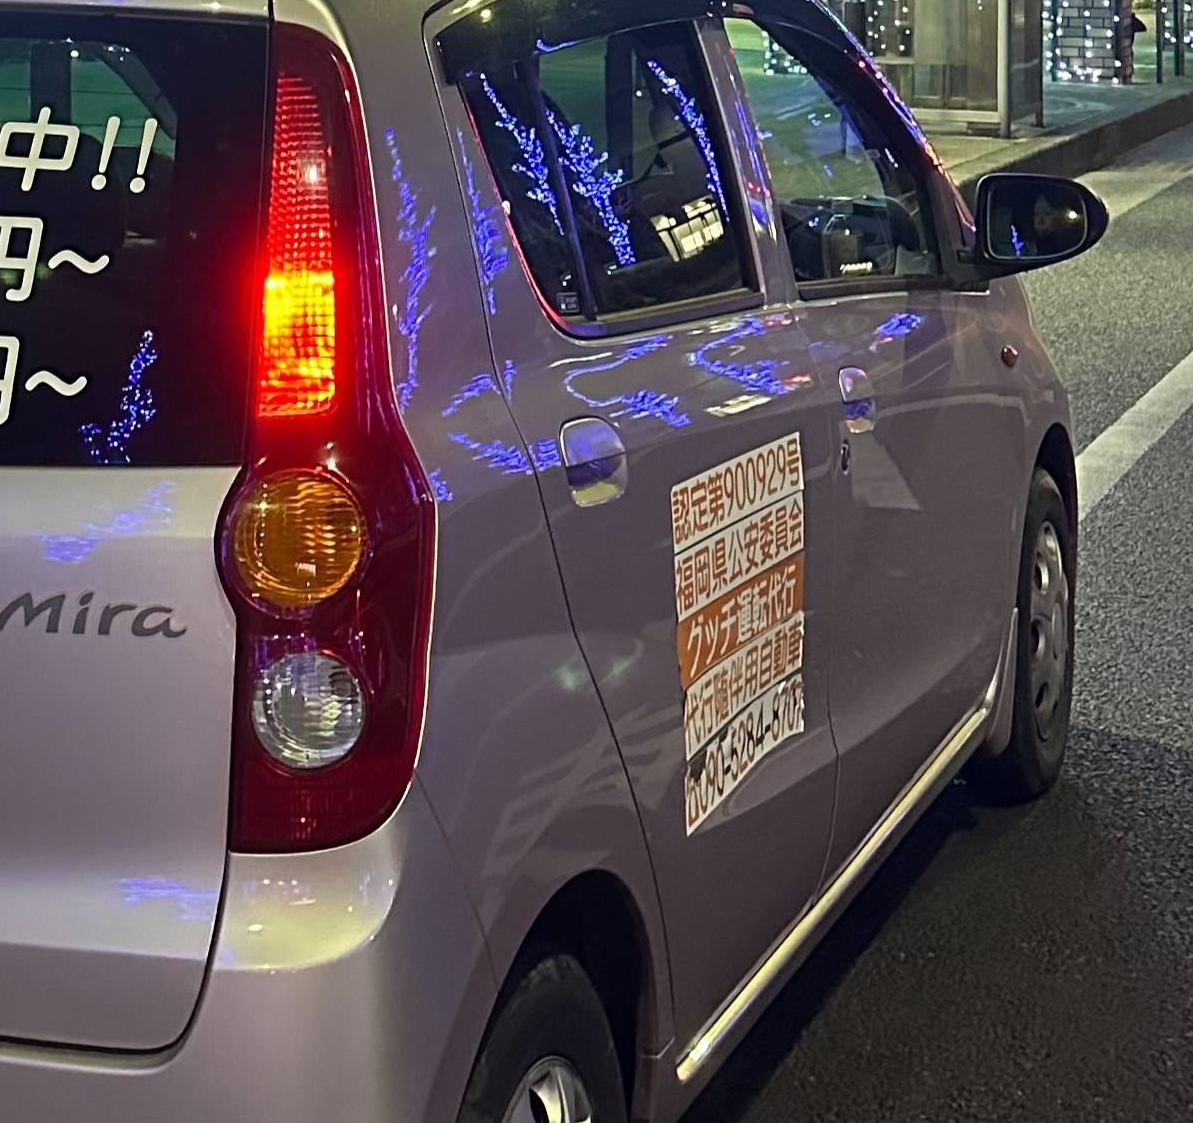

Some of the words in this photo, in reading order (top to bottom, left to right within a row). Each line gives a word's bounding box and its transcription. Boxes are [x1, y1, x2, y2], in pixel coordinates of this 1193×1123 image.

[672, 437, 801, 545] 認定第900929号
[676, 498, 802, 616] 福岡県公安委員会
[687, 563, 797, 678] グッチ運転代行
